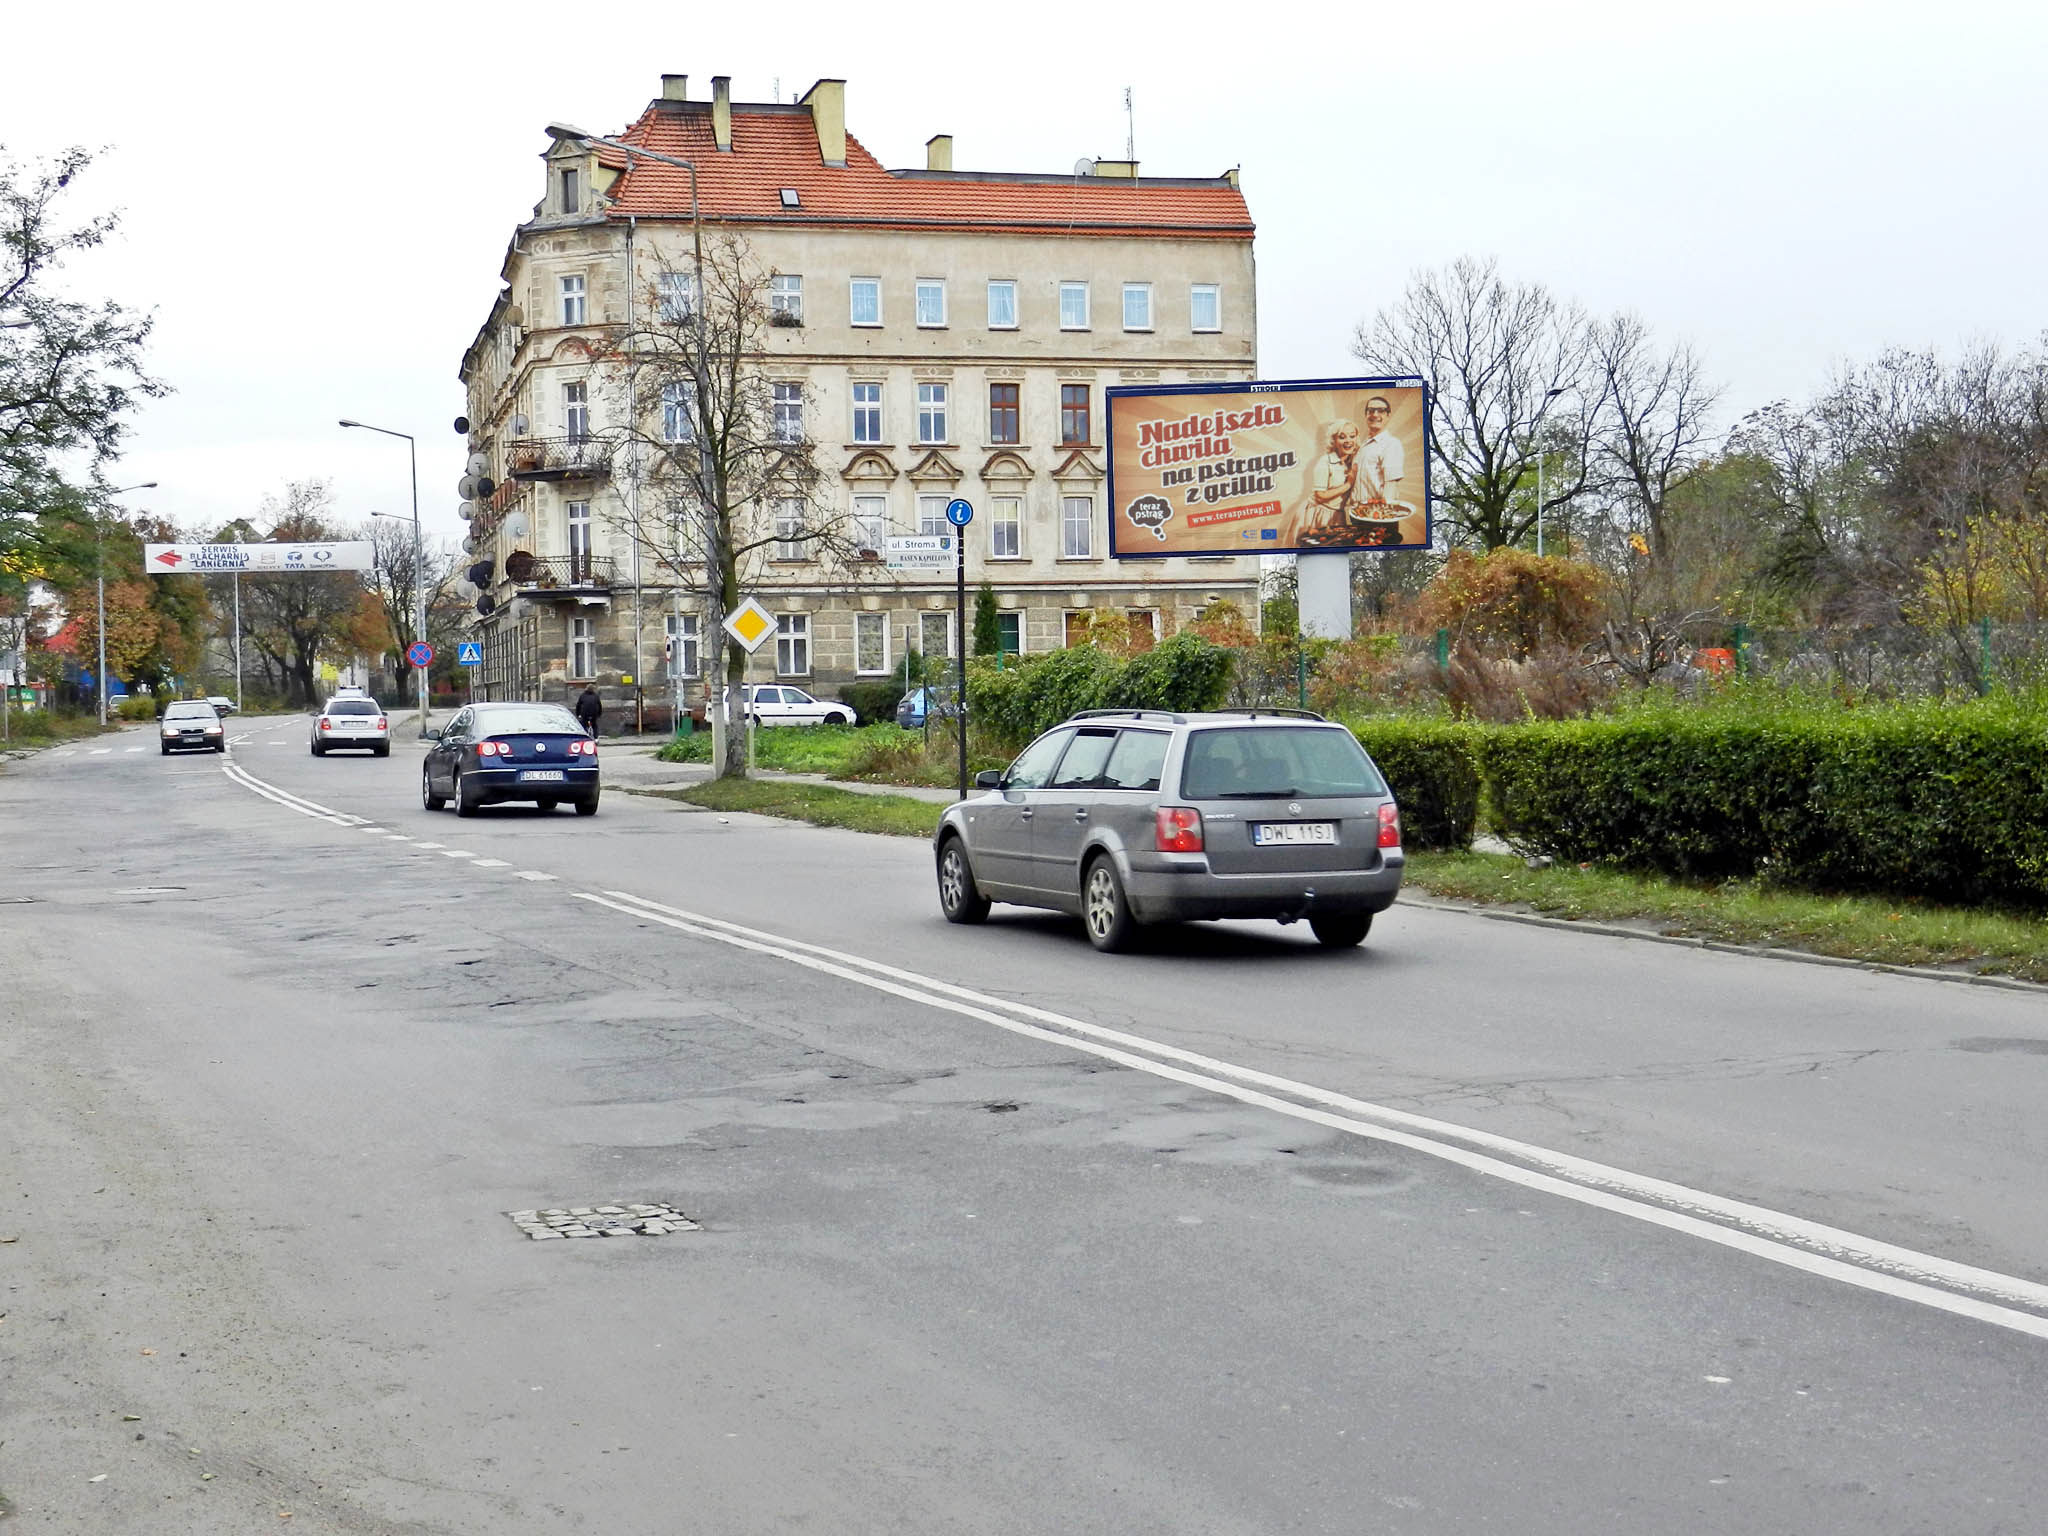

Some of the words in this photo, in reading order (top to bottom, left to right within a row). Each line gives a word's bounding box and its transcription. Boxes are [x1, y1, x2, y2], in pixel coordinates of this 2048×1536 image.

[1139, 404, 1285, 446] Nadejszła
[1141, 437, 1233, 467] chwila
[1162, 467, 1195, 486] na
[1186, 487, 1201, 503] z
[1204, 475, 1275, 503] grilla
[1135, 510, 1164, 520] pstrąg
[201, 545, 238, 553] SERWIS
[905, 541, 936, 549] Stroma
[190, 552, 250, 561] BLACHARNIA
[195, 560, 246, 568] LAKIERNIA
[1263, 825, 1294, 841] DWL
[1299, 825, 1331, 840] 11SJ
